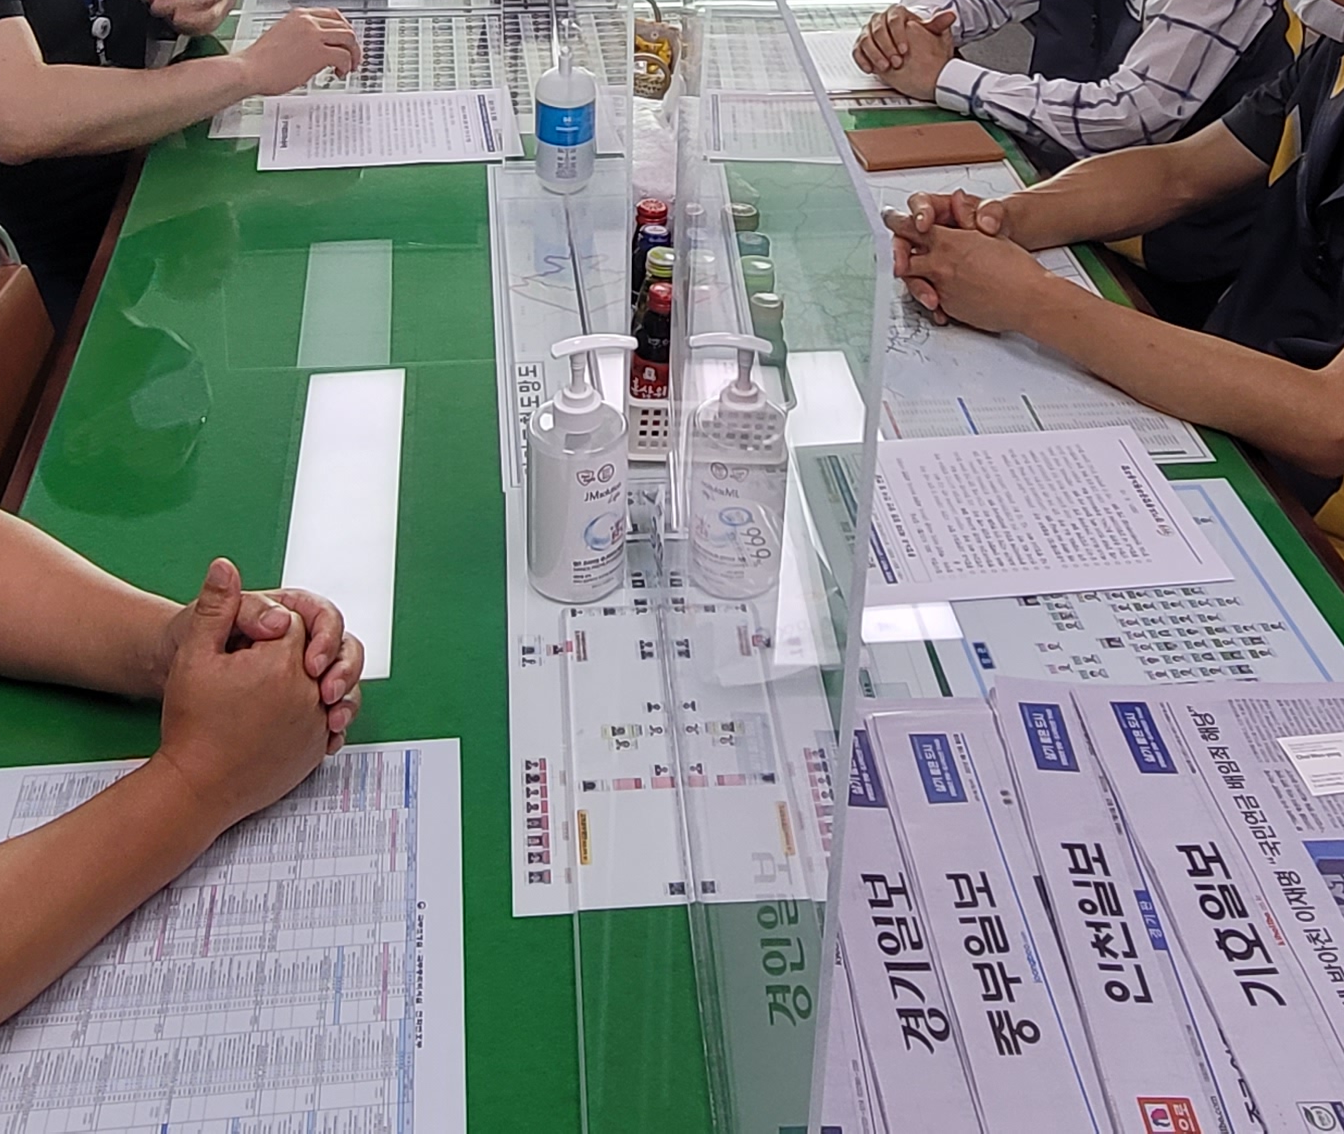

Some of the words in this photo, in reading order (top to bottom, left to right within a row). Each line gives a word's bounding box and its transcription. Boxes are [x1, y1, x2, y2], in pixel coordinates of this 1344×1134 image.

[1209, 745, 1246, 791] 배임죄
[861, 870, 951, 1055] 경기일보
[947, 870, 1041, 1057] 중부일보
[1062, 841, 1154, 1006] 인천일보
[1176, 840, 1286, 1008] 기호일보
[1278, 869, 1316, 923] 이재명
